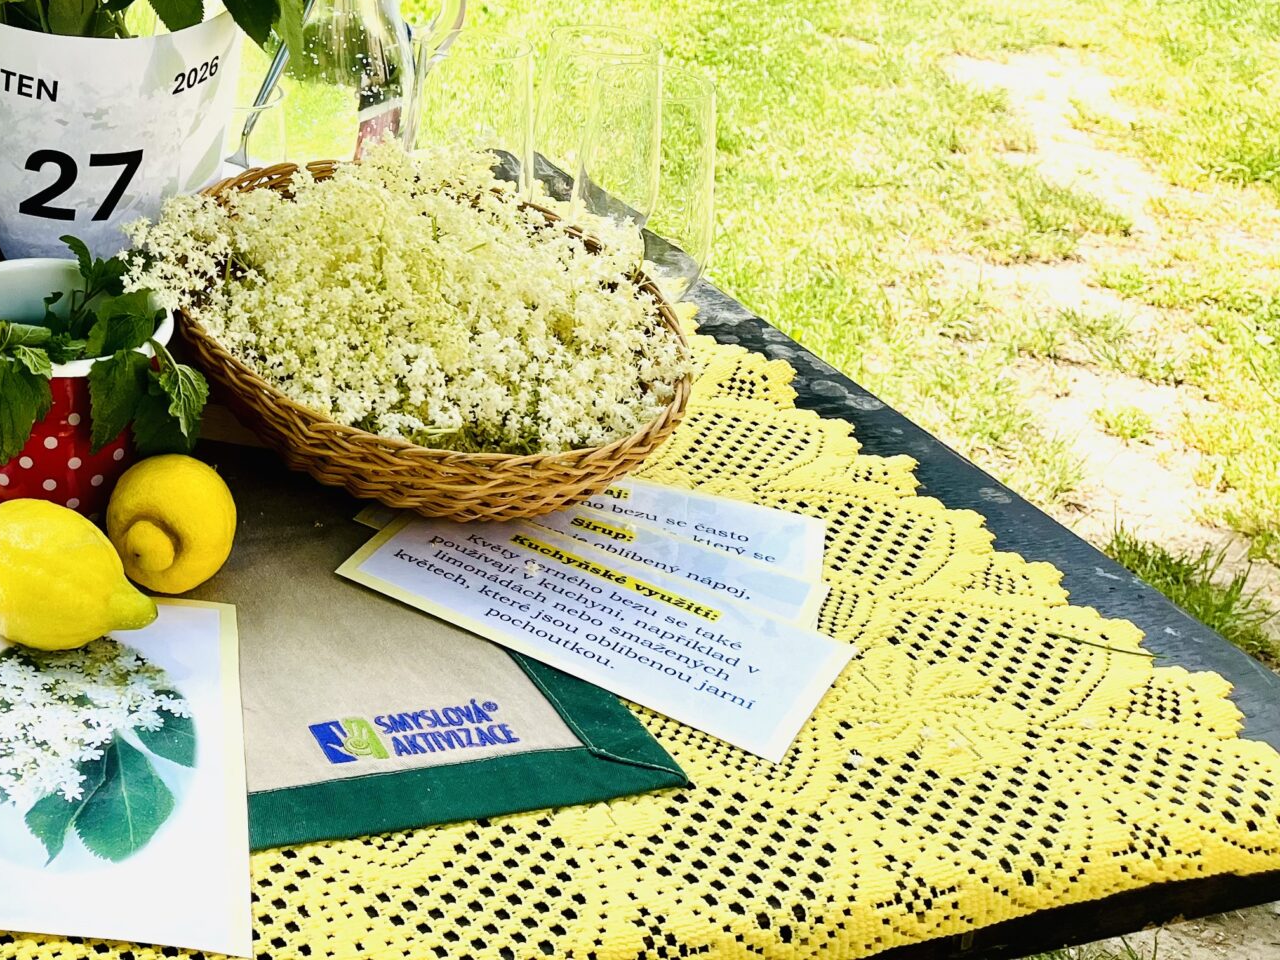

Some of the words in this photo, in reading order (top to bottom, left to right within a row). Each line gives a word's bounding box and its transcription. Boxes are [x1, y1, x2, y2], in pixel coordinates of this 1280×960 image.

[172, 55, 219, 94] 2026
[19, 149, 144, 221] 27
[570, 516, 634, 543] Sirup:
[611, 504, 658, 522] bezu
[665, 517, 688, 528] se
[694, 522, 749, 543] často
[510, 534, 627, 585] Kuchyňské
[635, 584, 721, 621] využití:
[593, 541, 680, 575] oblíbený
[686, 571, 752, 601] nápoj,
[753, 552, 777, 564] se
[428, 534, 517, 575] používají
[522, 572, 535, 581] v
[537, 577, 625, 622] kuchyni,
[634, 617, 741, 668] například
[748, 665, 761, 675] v
[432, 549, 547, 604] limonádách
[552, 601, 604, 627] nebo
[609, 626, 731, 682] smažených
[467, 533, 521, 560] Květy
[524, 558, 603, 594] černého
[609, 591, 658, 618] bezu
[664, 614, 688, 629] se
[694, 626, 743, 651] také
[393, 547, 471, 589] květech,
[478, 584, 531, 612] které
[530, 609, 580, 635] jsou
[585, 632, 692, 684] oblíbenou
[694, 679, 757, 711] jarní
[484, 607, 615, 670] pochoutkou.
[391, 723, 520, 757] AKTIVIZACE
